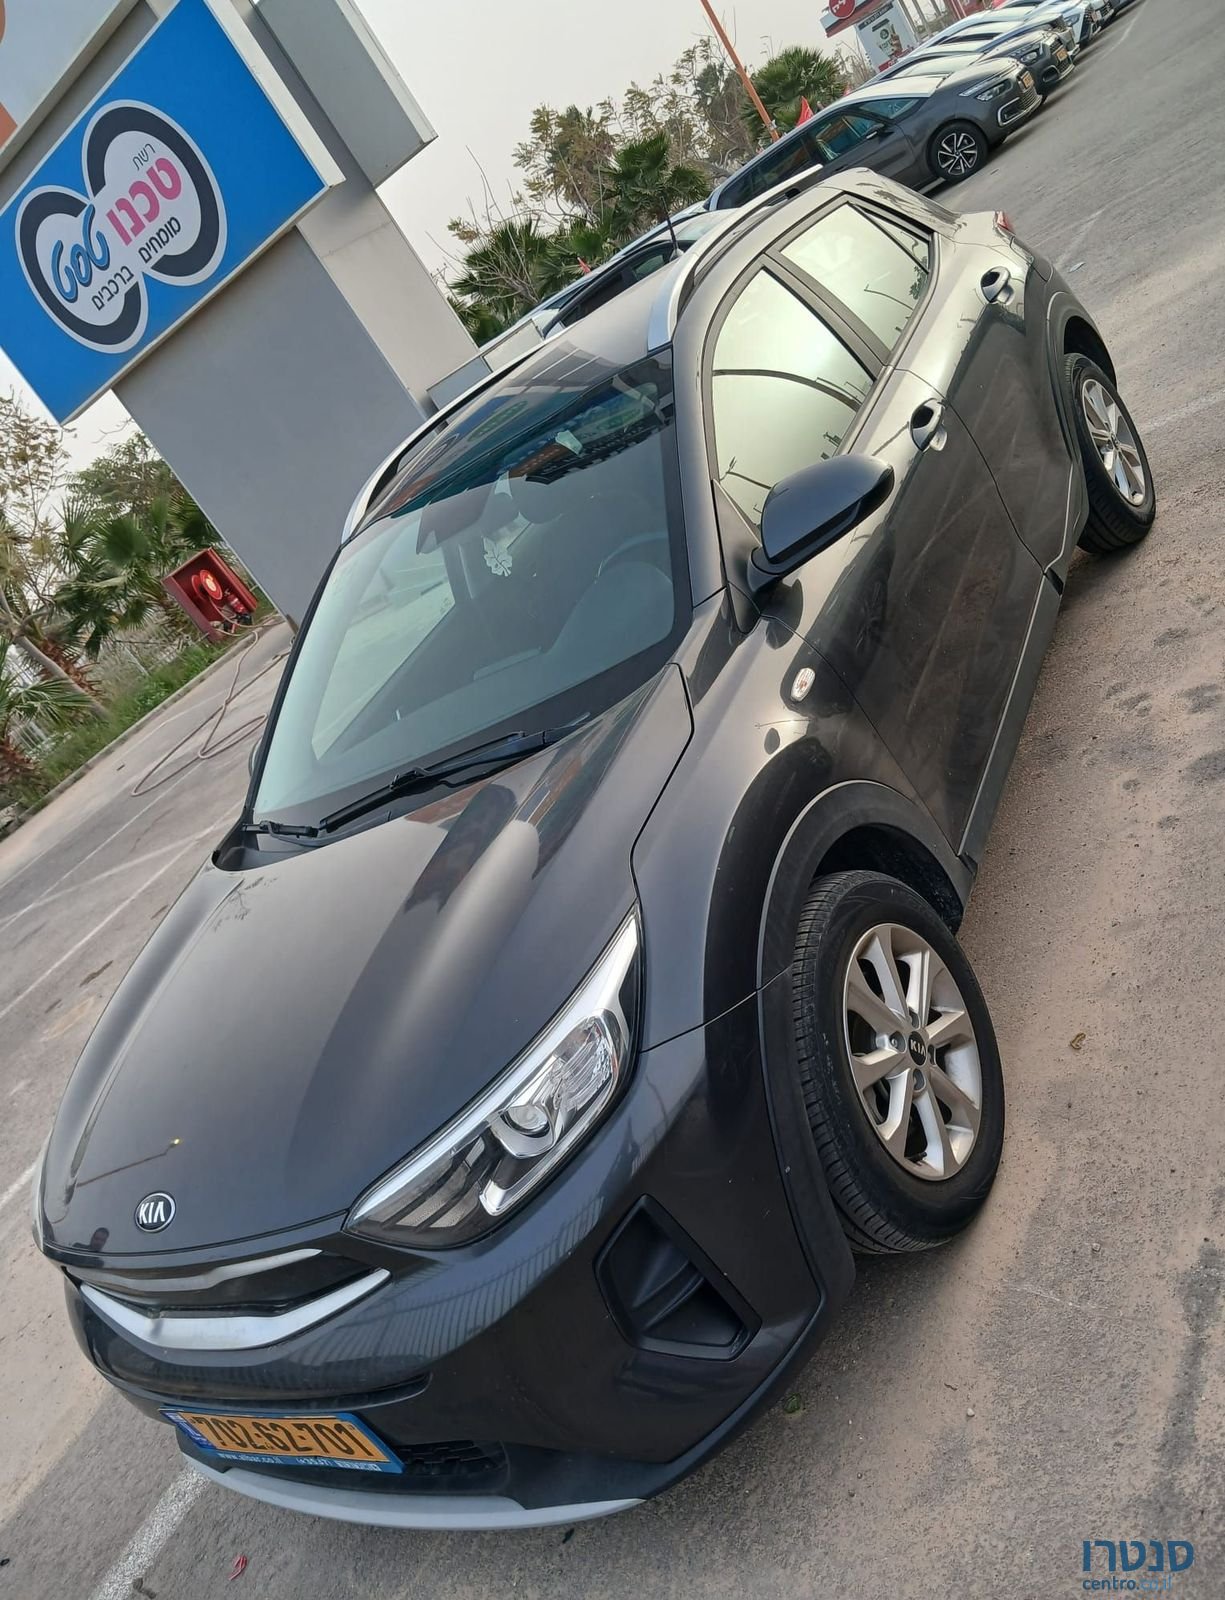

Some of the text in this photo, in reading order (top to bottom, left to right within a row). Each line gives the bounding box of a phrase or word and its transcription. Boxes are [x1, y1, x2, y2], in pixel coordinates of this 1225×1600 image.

[132, 143, 156, 171] רשת
[51, 157, 183, 304] טכנו טסט
[91, 216, 182, 311] מומחים ברכבים
[910, 1039, 926, 1057] KIA
[139, 1201, 166, 1224] KIA
